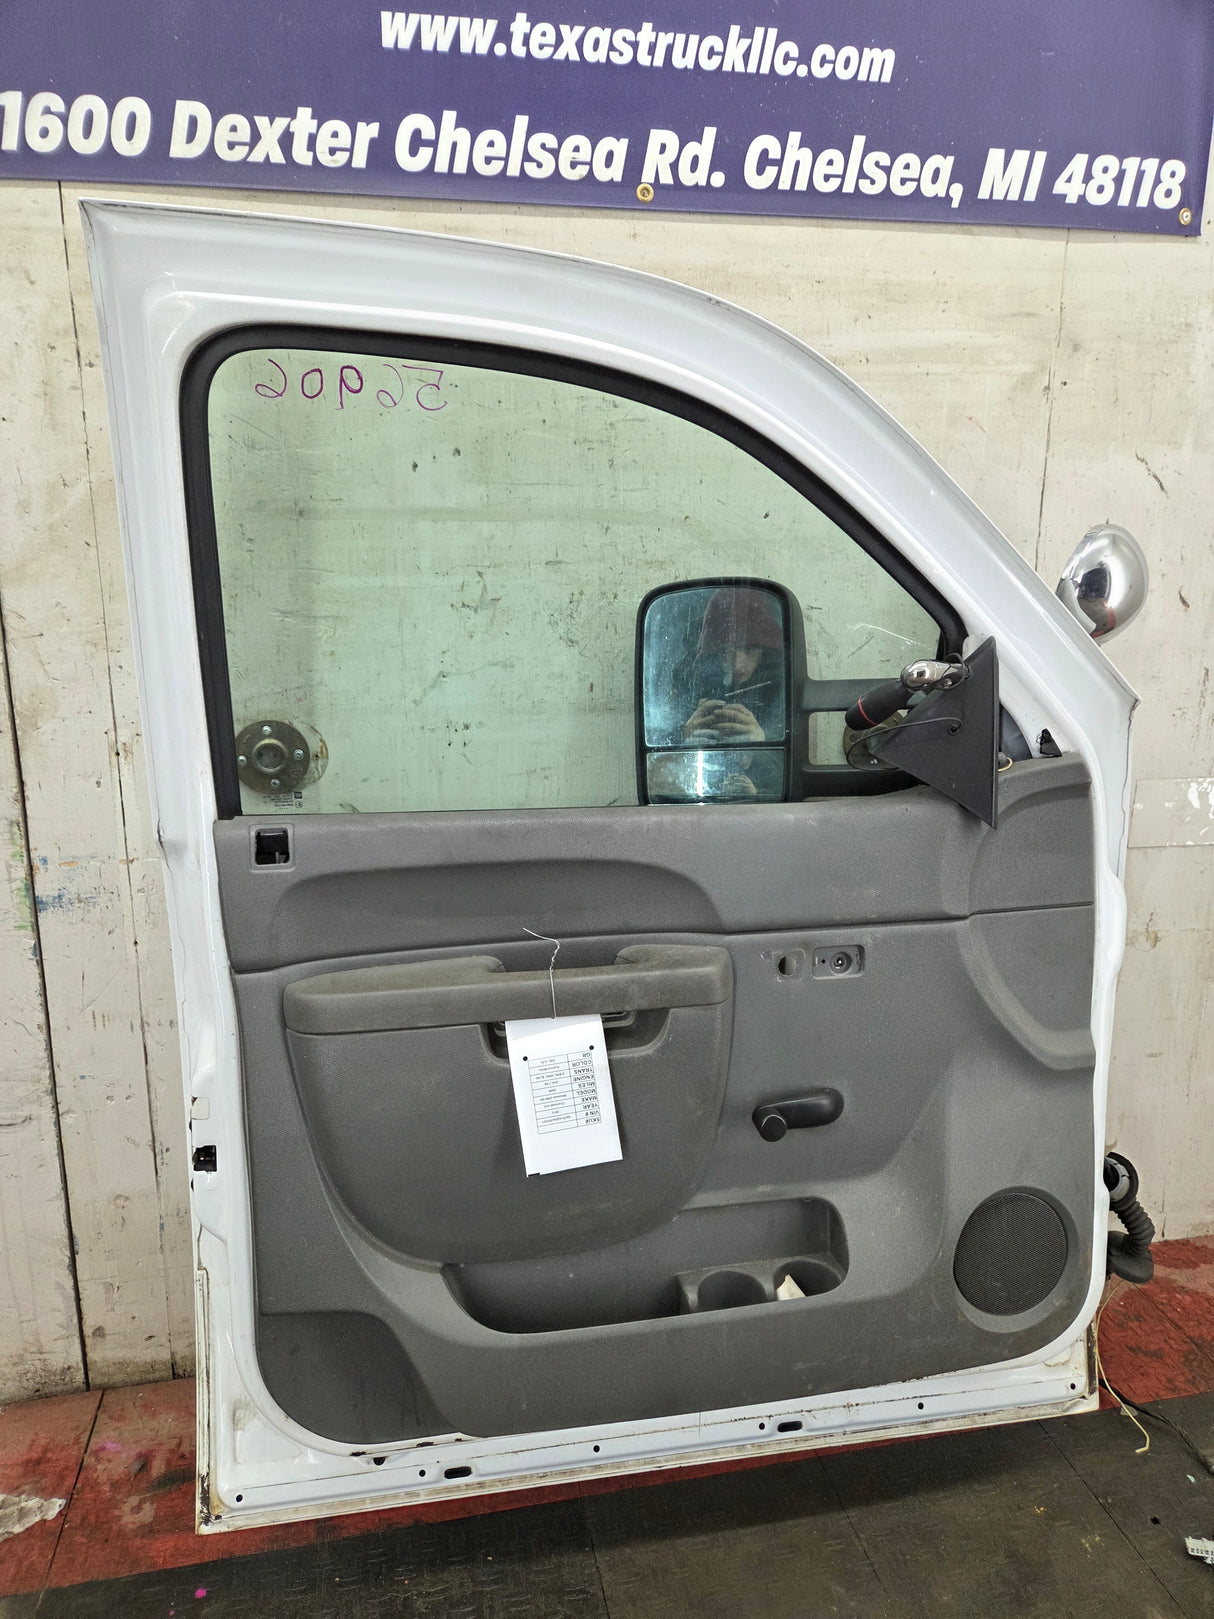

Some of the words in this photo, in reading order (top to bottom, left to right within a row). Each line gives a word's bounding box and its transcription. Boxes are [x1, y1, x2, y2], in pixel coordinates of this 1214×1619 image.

[381, 11, 896, 83] www.texastruckllc.com
[0, 91, 152, 156] 1600
[170, 100, 380, 168] Dexter
[394, 111, 629, 181] Chelsea
[641, 127, 726, 188] Rd.
[743, 131, 964, 209] Chelsea,
[977, 147, 1048, 202] MI
[1052, 154, 1187, 210] 48118
